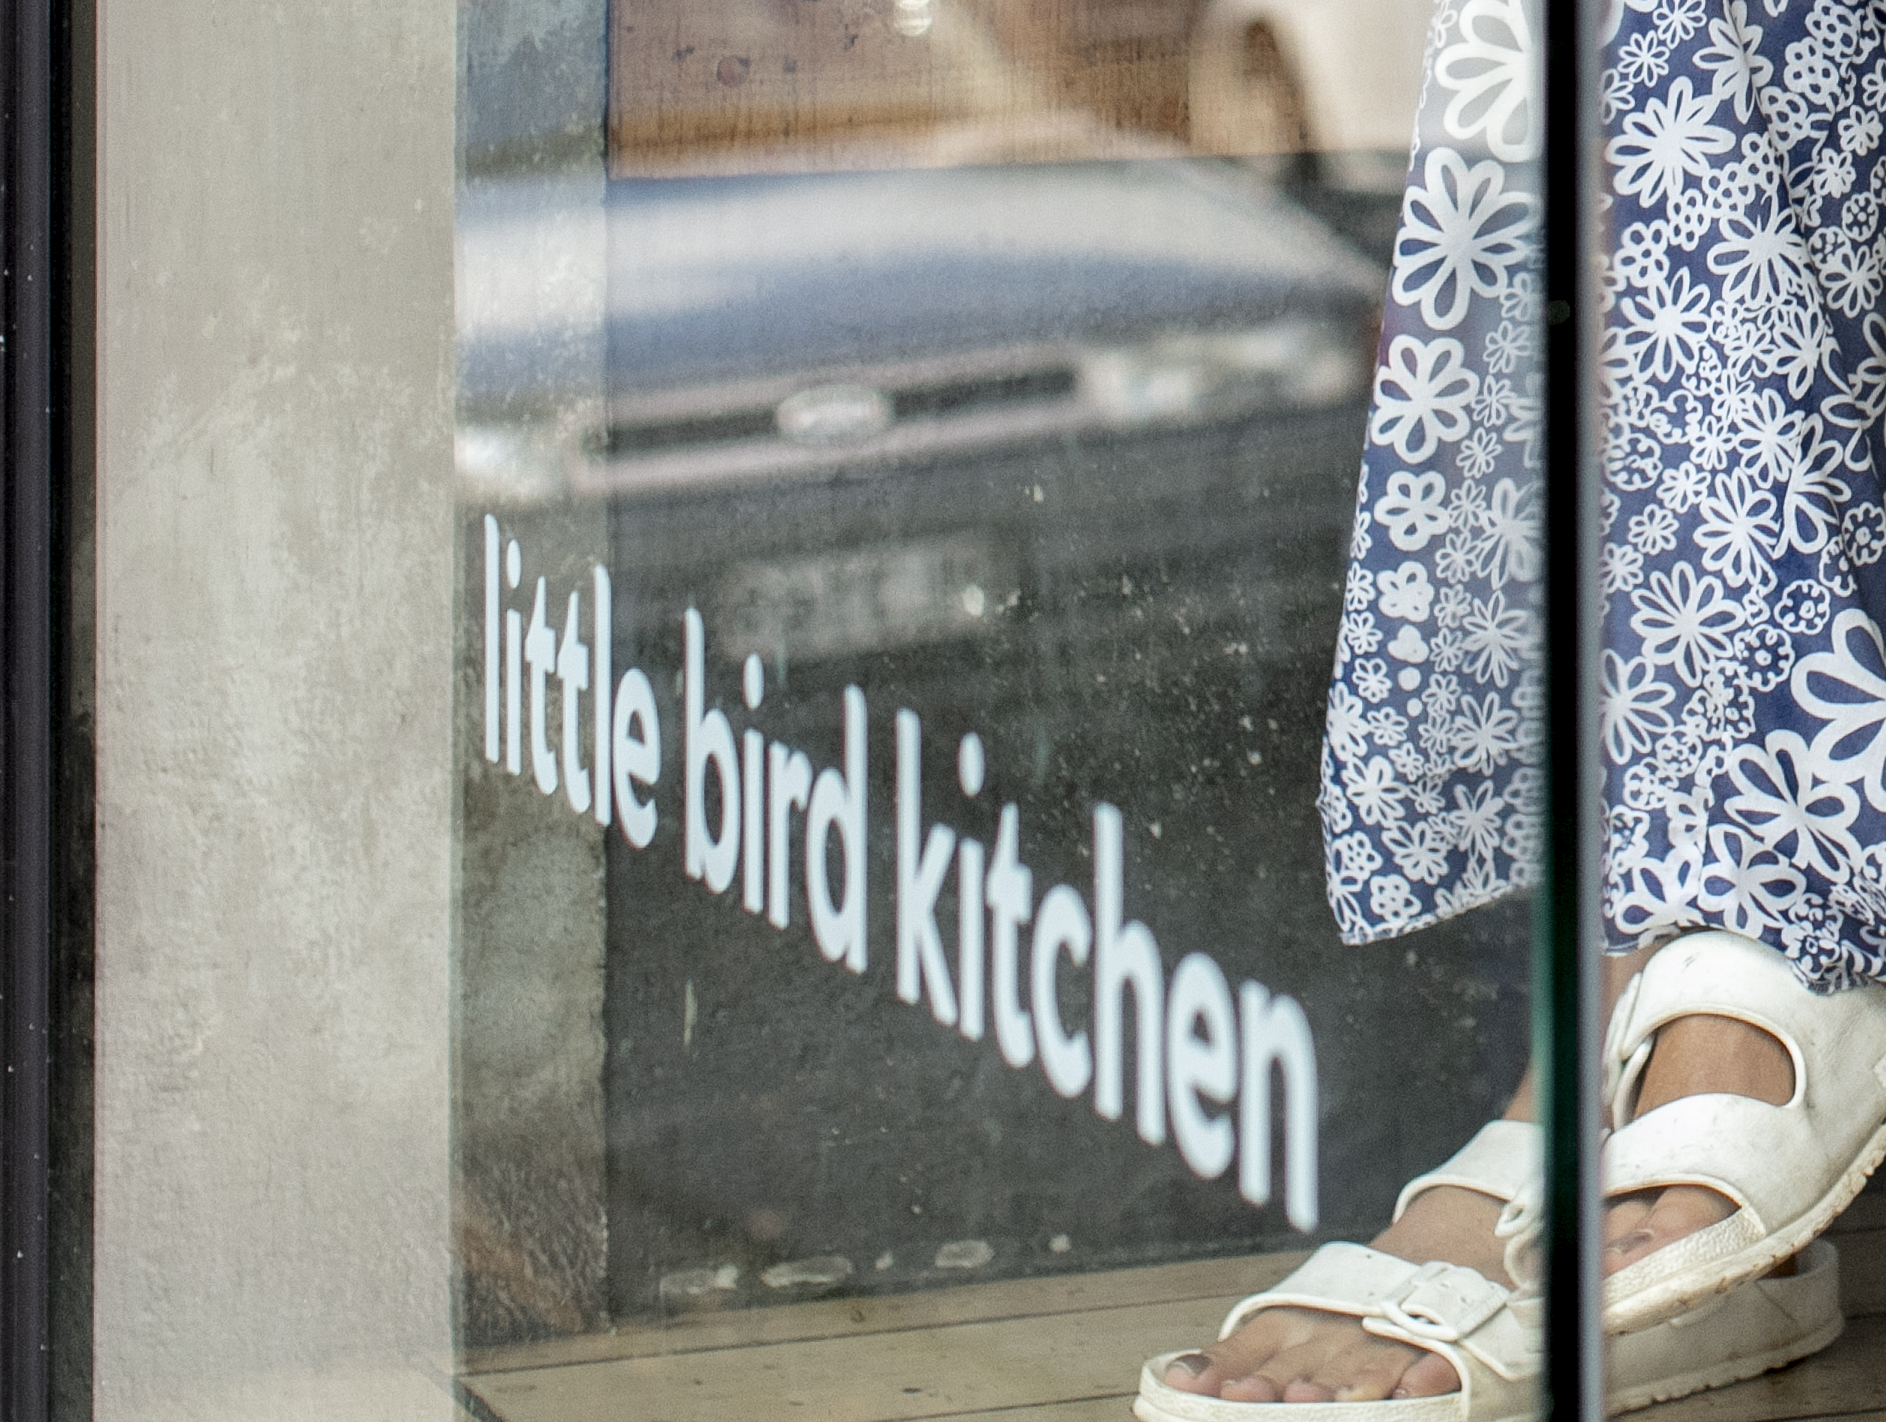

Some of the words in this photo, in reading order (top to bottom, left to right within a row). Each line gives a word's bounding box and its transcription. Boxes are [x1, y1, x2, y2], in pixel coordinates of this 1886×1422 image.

[484, 512, 662, 849] little
[682, 605, 870, 975] bird
[896, 707, 1319, 1234] kitchen
